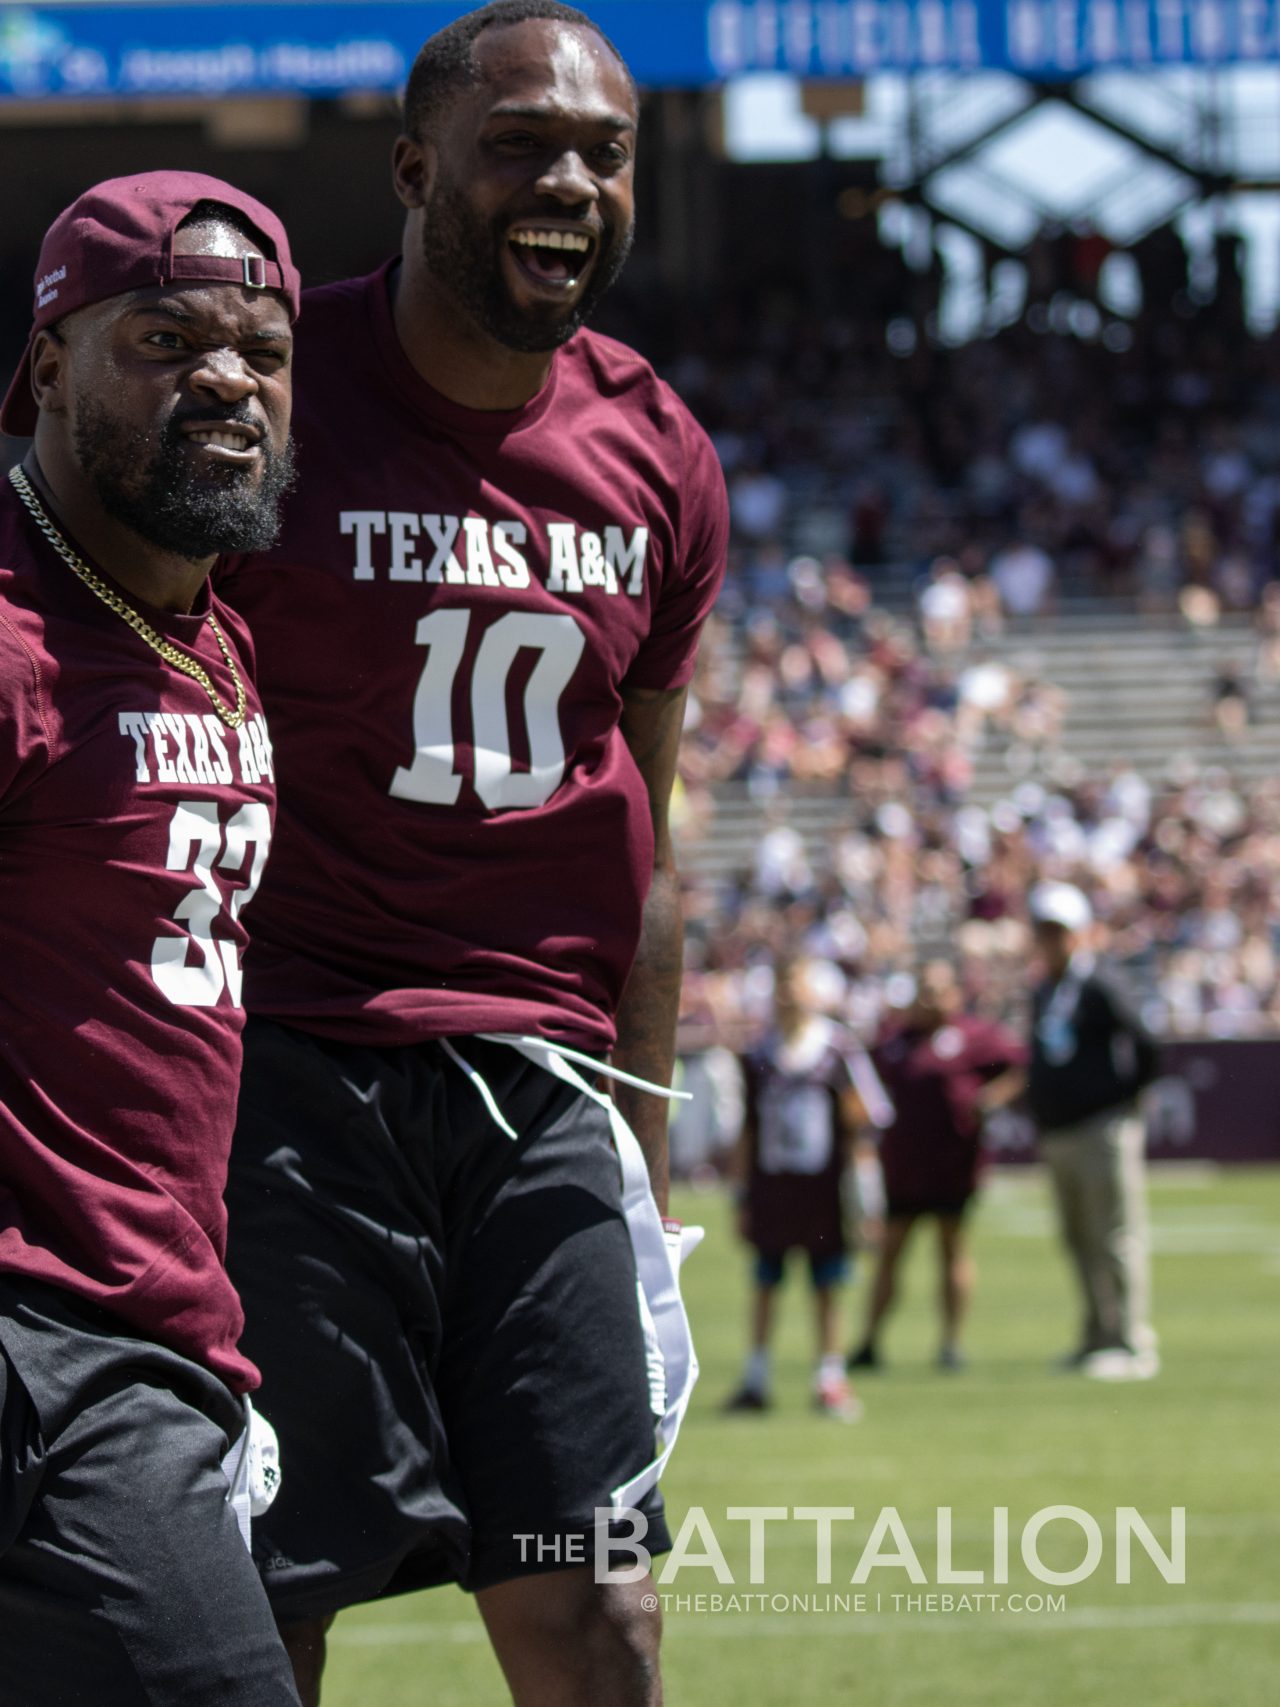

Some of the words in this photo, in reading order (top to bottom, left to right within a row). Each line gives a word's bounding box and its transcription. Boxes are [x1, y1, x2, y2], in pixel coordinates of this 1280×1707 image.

[1007, 0, 1280, 68] HEALTHC
[339, 510, 531, 589] TEXAS
[545, 523, 648, 596] A&M
[118, 712, 233, 785] TEXAS
[388, 608, 586, 811] 10
